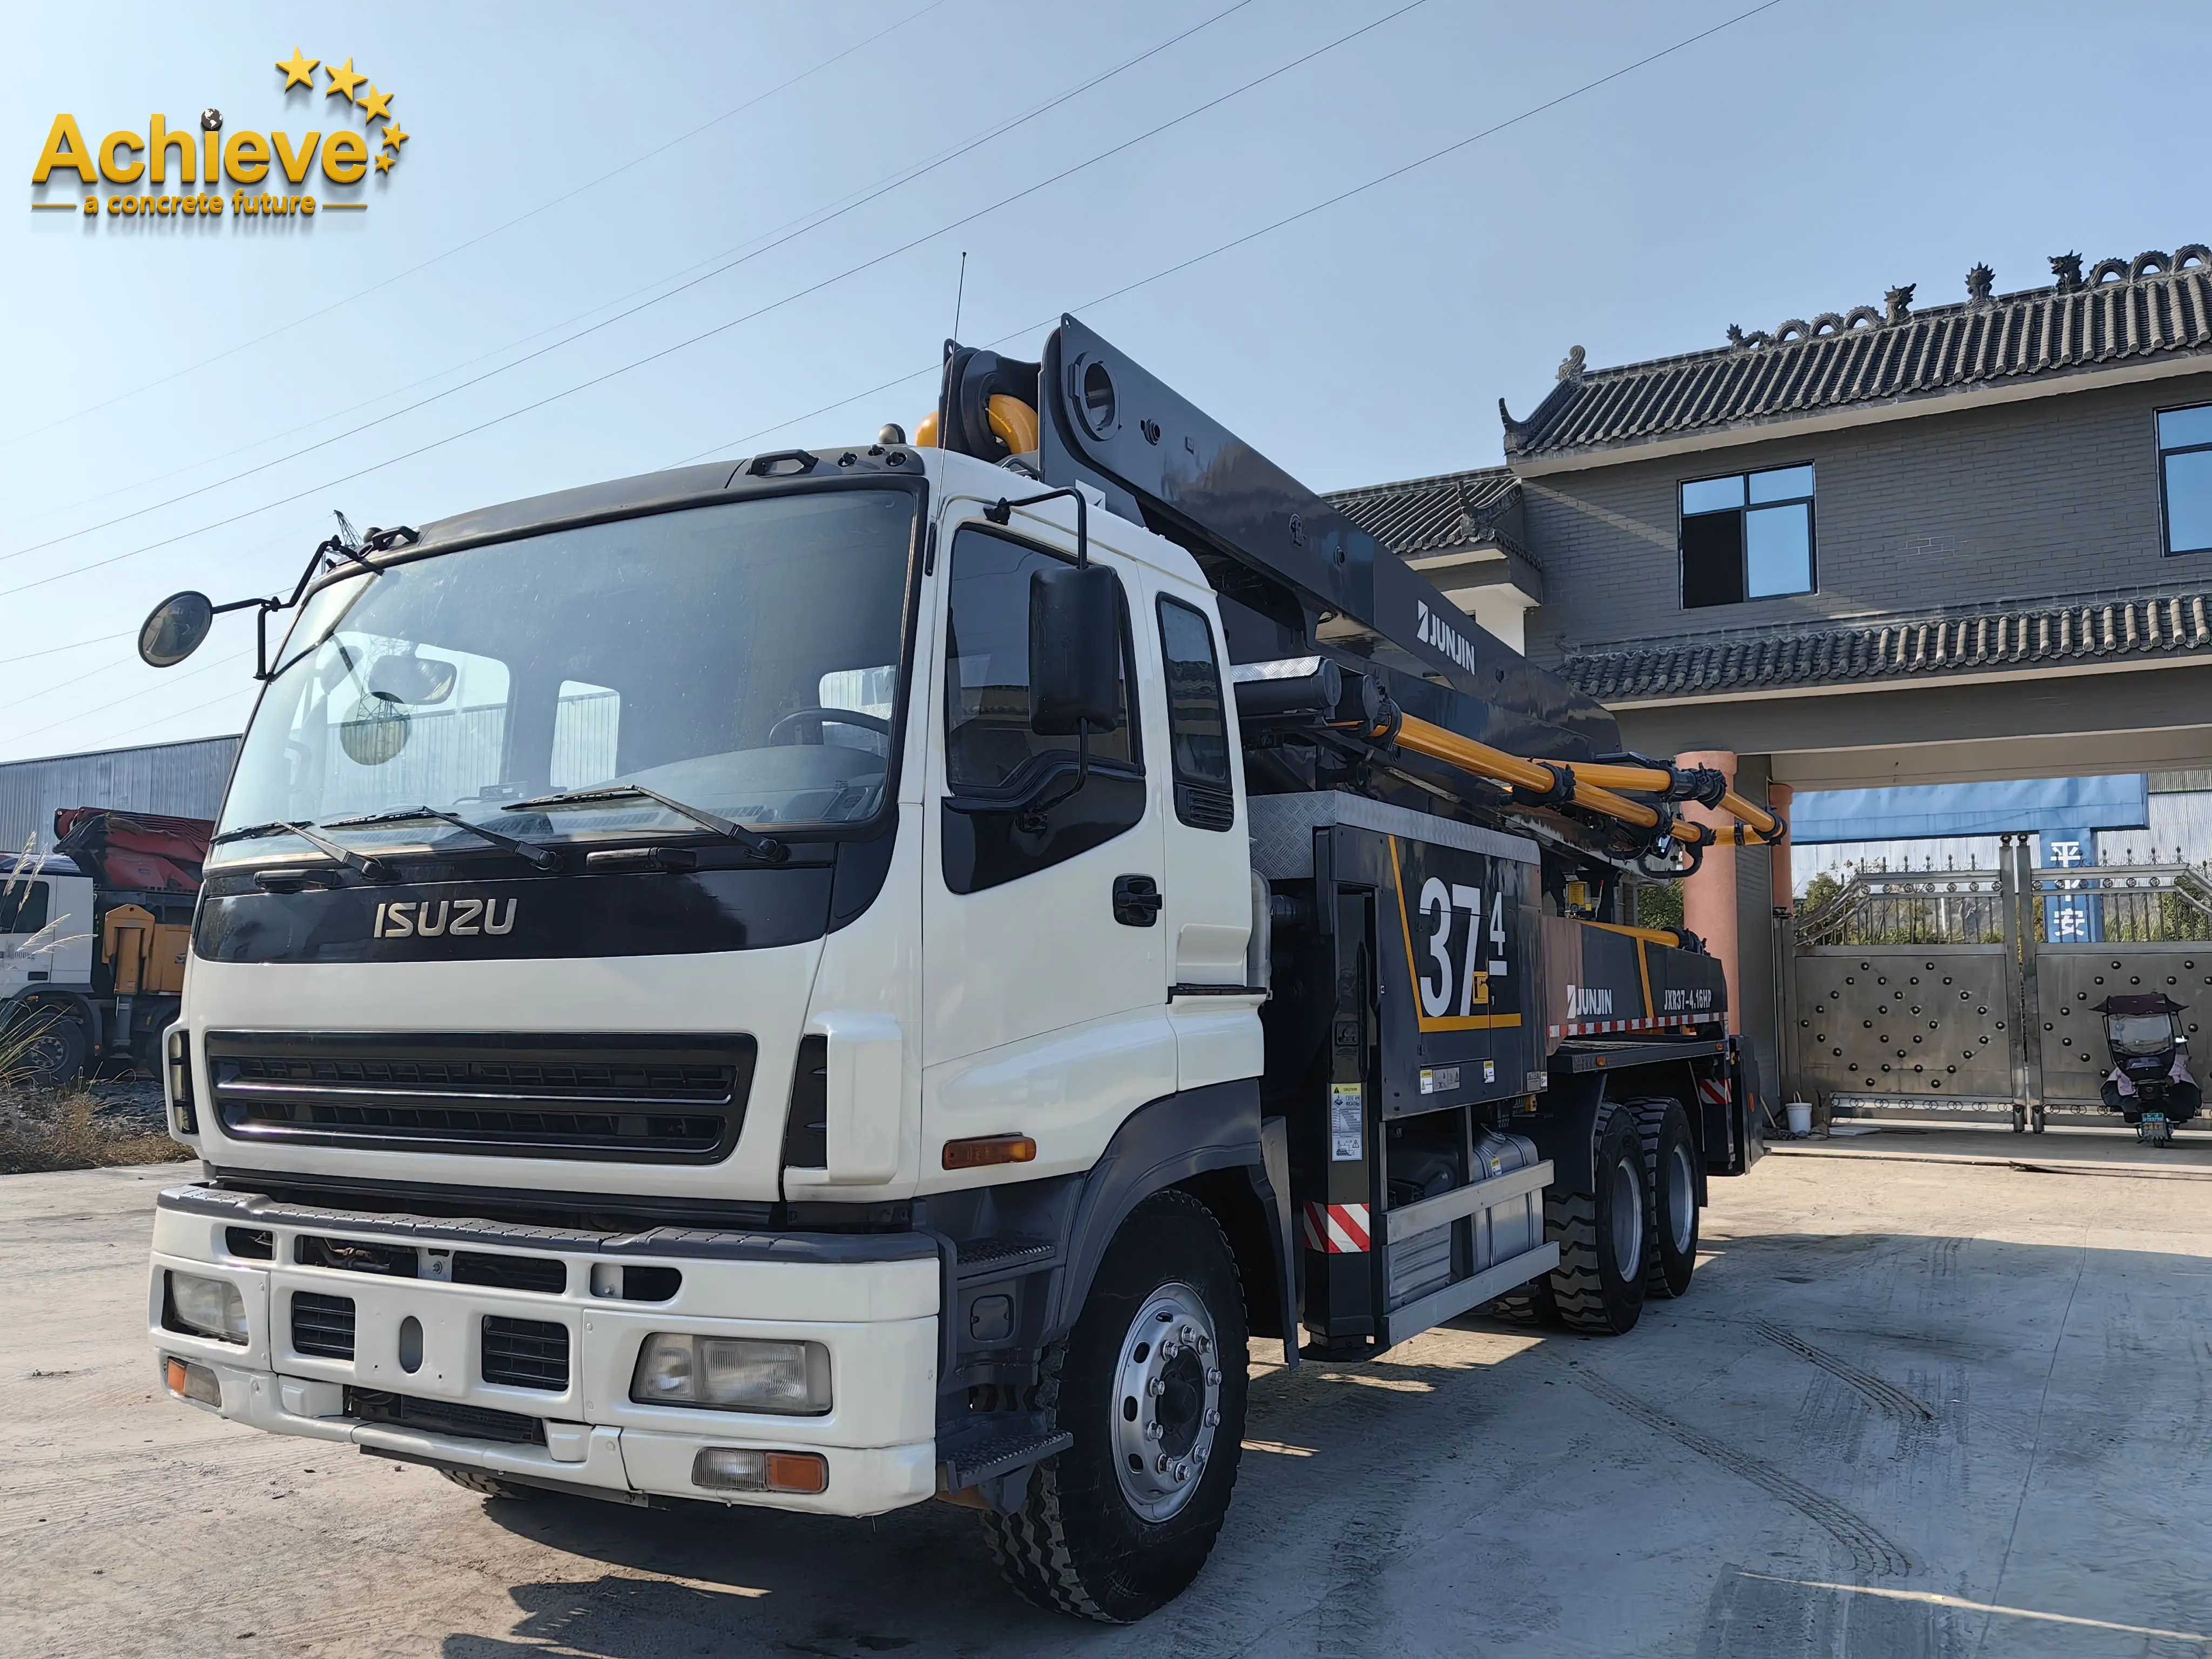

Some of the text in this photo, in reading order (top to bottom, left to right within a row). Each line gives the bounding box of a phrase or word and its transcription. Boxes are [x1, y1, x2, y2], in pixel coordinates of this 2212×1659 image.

[1430, 613, 1475, 676] JUNJIN
[374, 898, 518, 939] ISUZU
[1419, 877, 1480, 1017] 37
[1576, 988, 1613, 1015] JUNJIN
[1664, 989, 1711, 1010] JXR37-4.16HP
